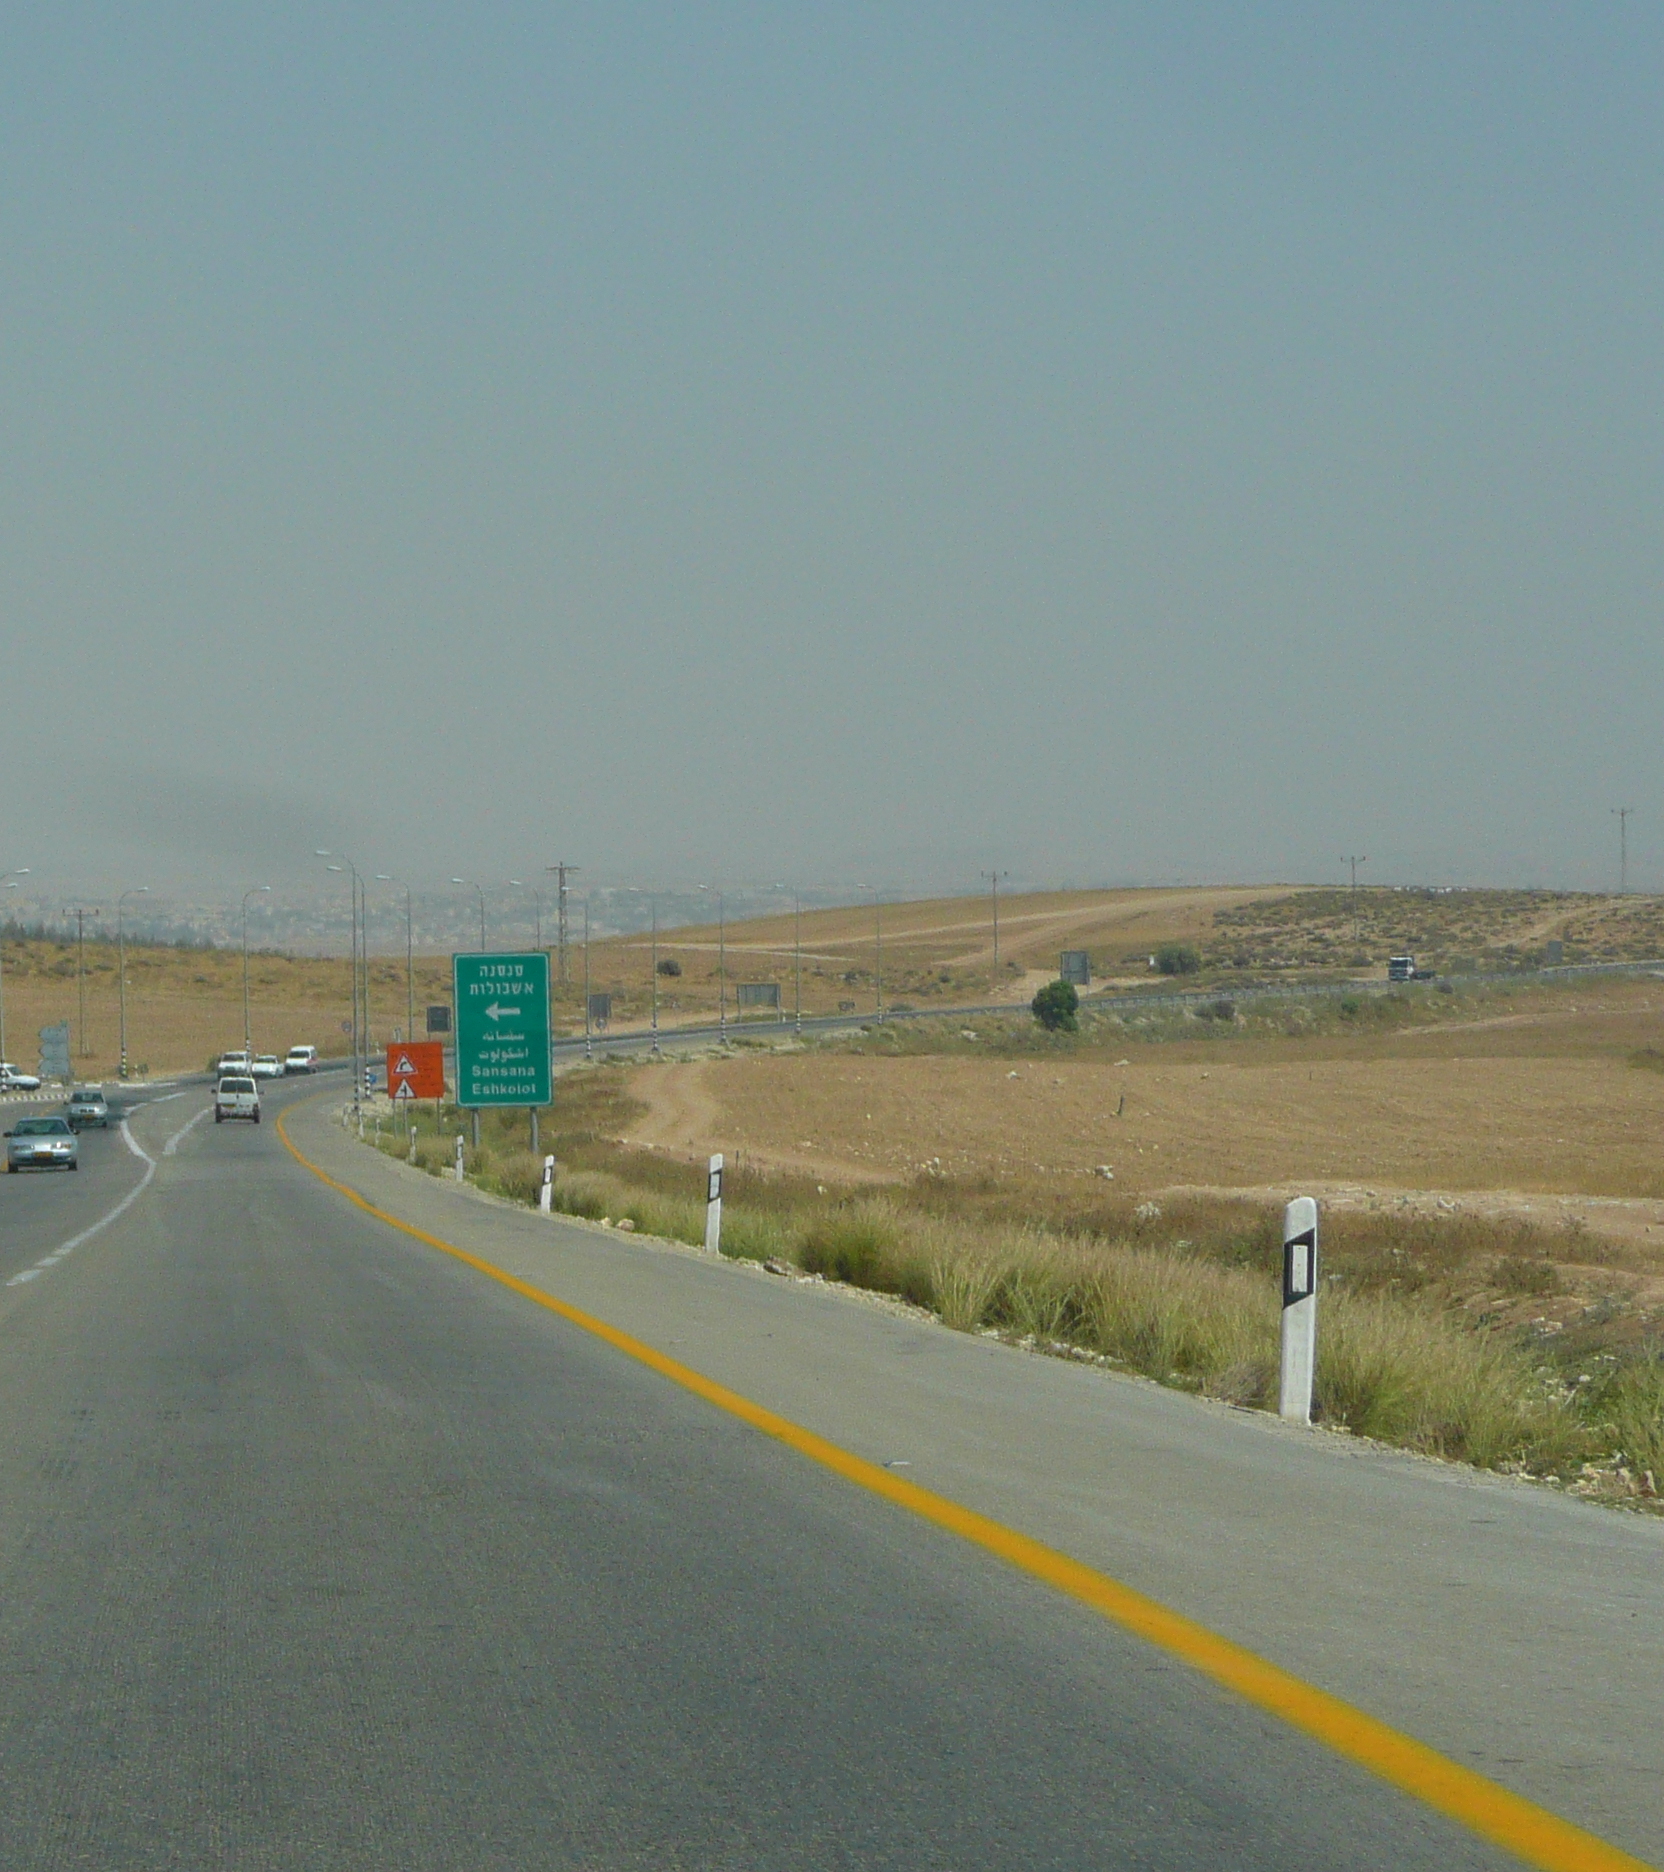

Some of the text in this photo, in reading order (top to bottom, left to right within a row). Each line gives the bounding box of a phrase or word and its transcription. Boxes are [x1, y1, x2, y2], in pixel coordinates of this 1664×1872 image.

[479, 964, 524, 977] סנסנה
[472, 1065, 536, 1078] Sansana
[472, 1083, 537, 1096] Eshkolot
